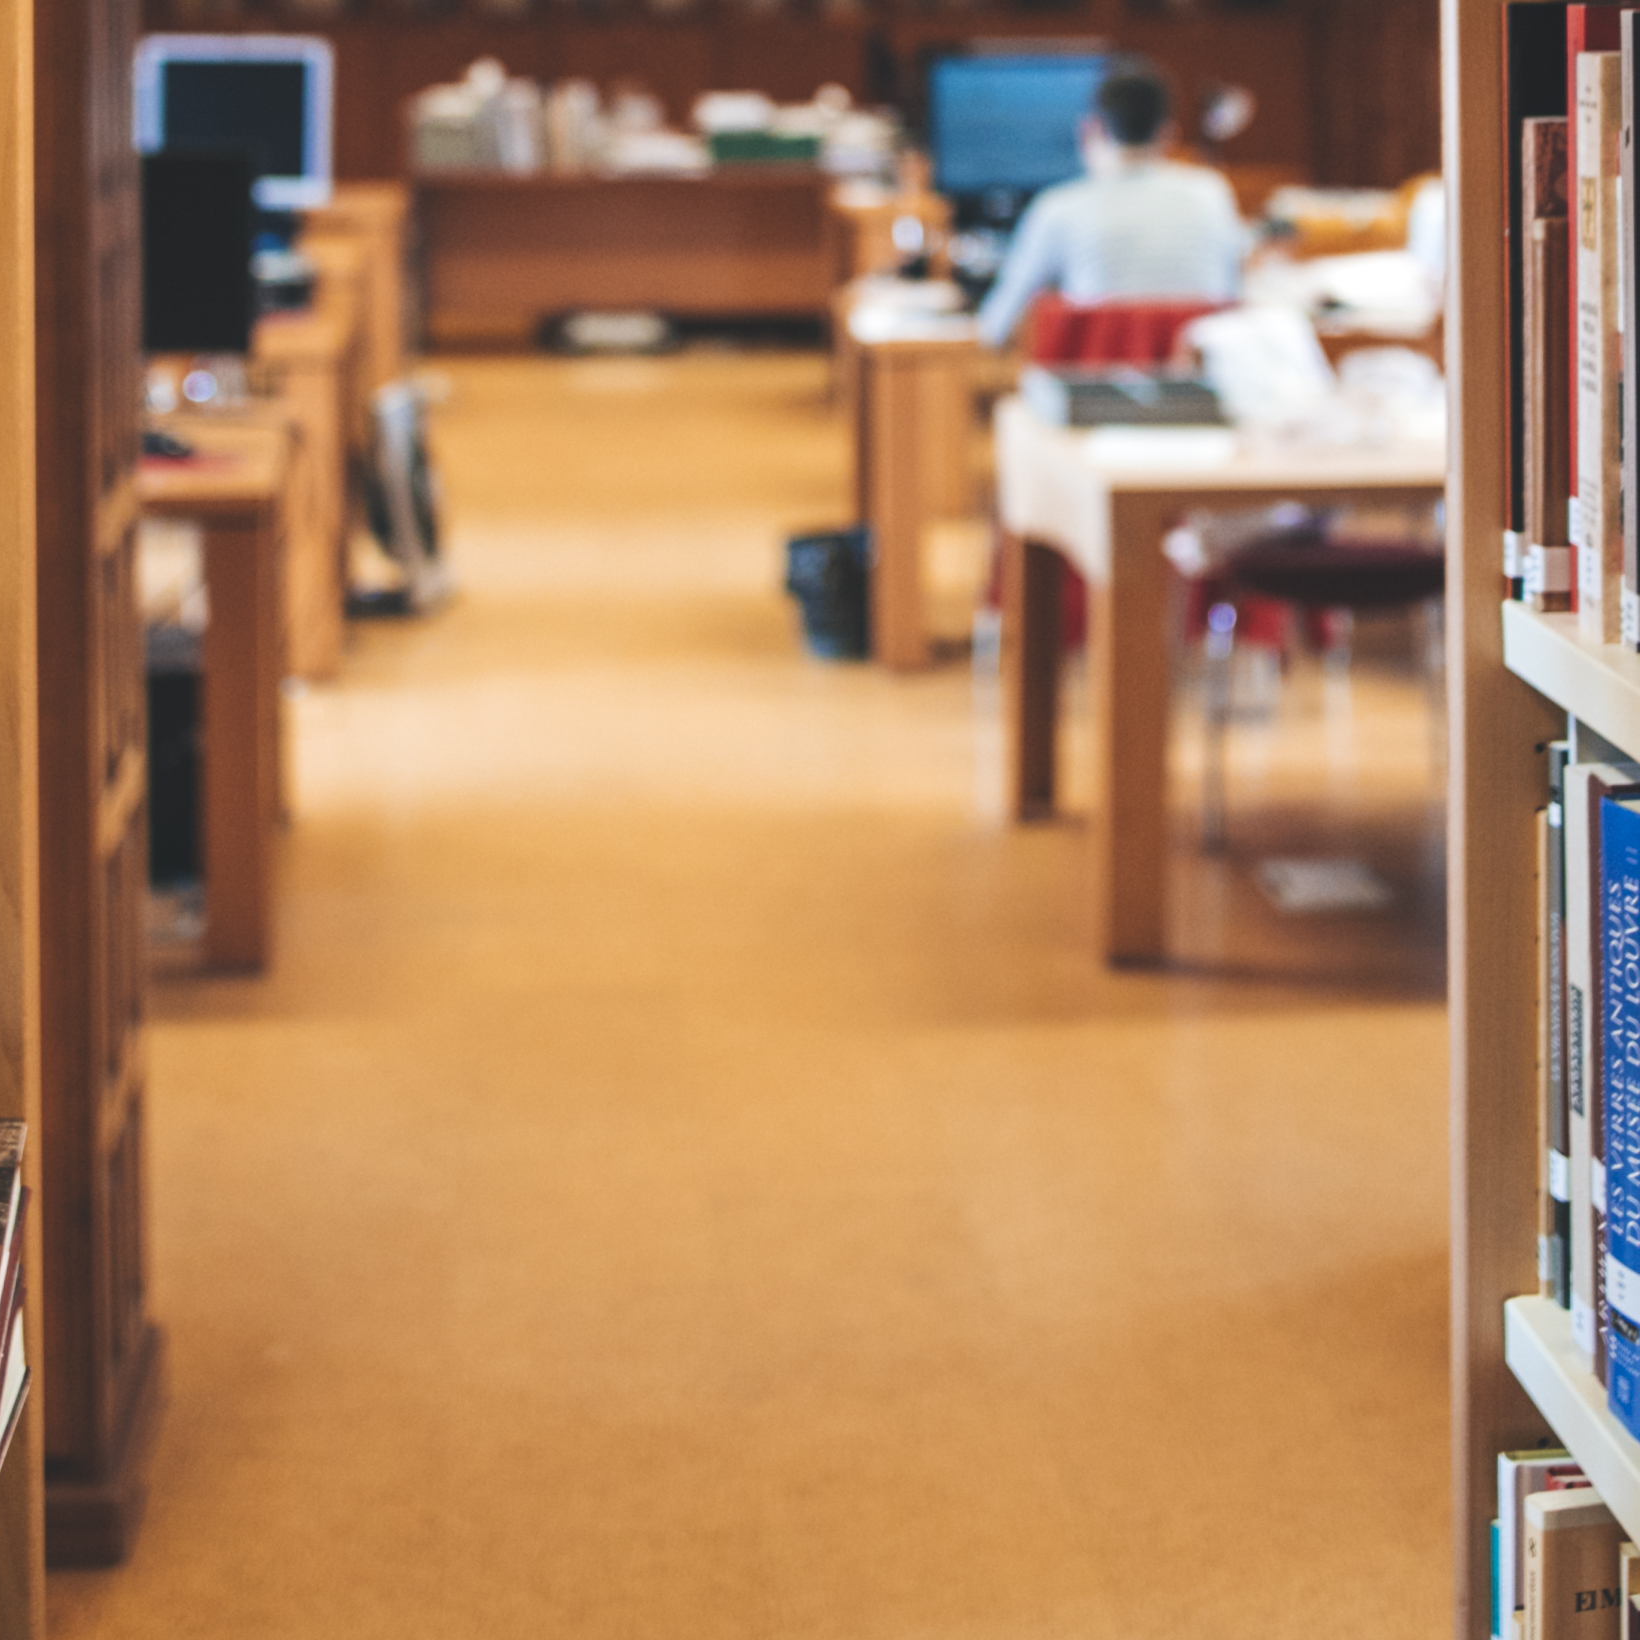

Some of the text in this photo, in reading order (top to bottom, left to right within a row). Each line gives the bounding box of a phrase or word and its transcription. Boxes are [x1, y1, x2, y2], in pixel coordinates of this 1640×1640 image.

[1607, 879, 1624, 1236] LES VERRES ANTIQUES
[1623, 875, 1640, 1006] LOUVRE
